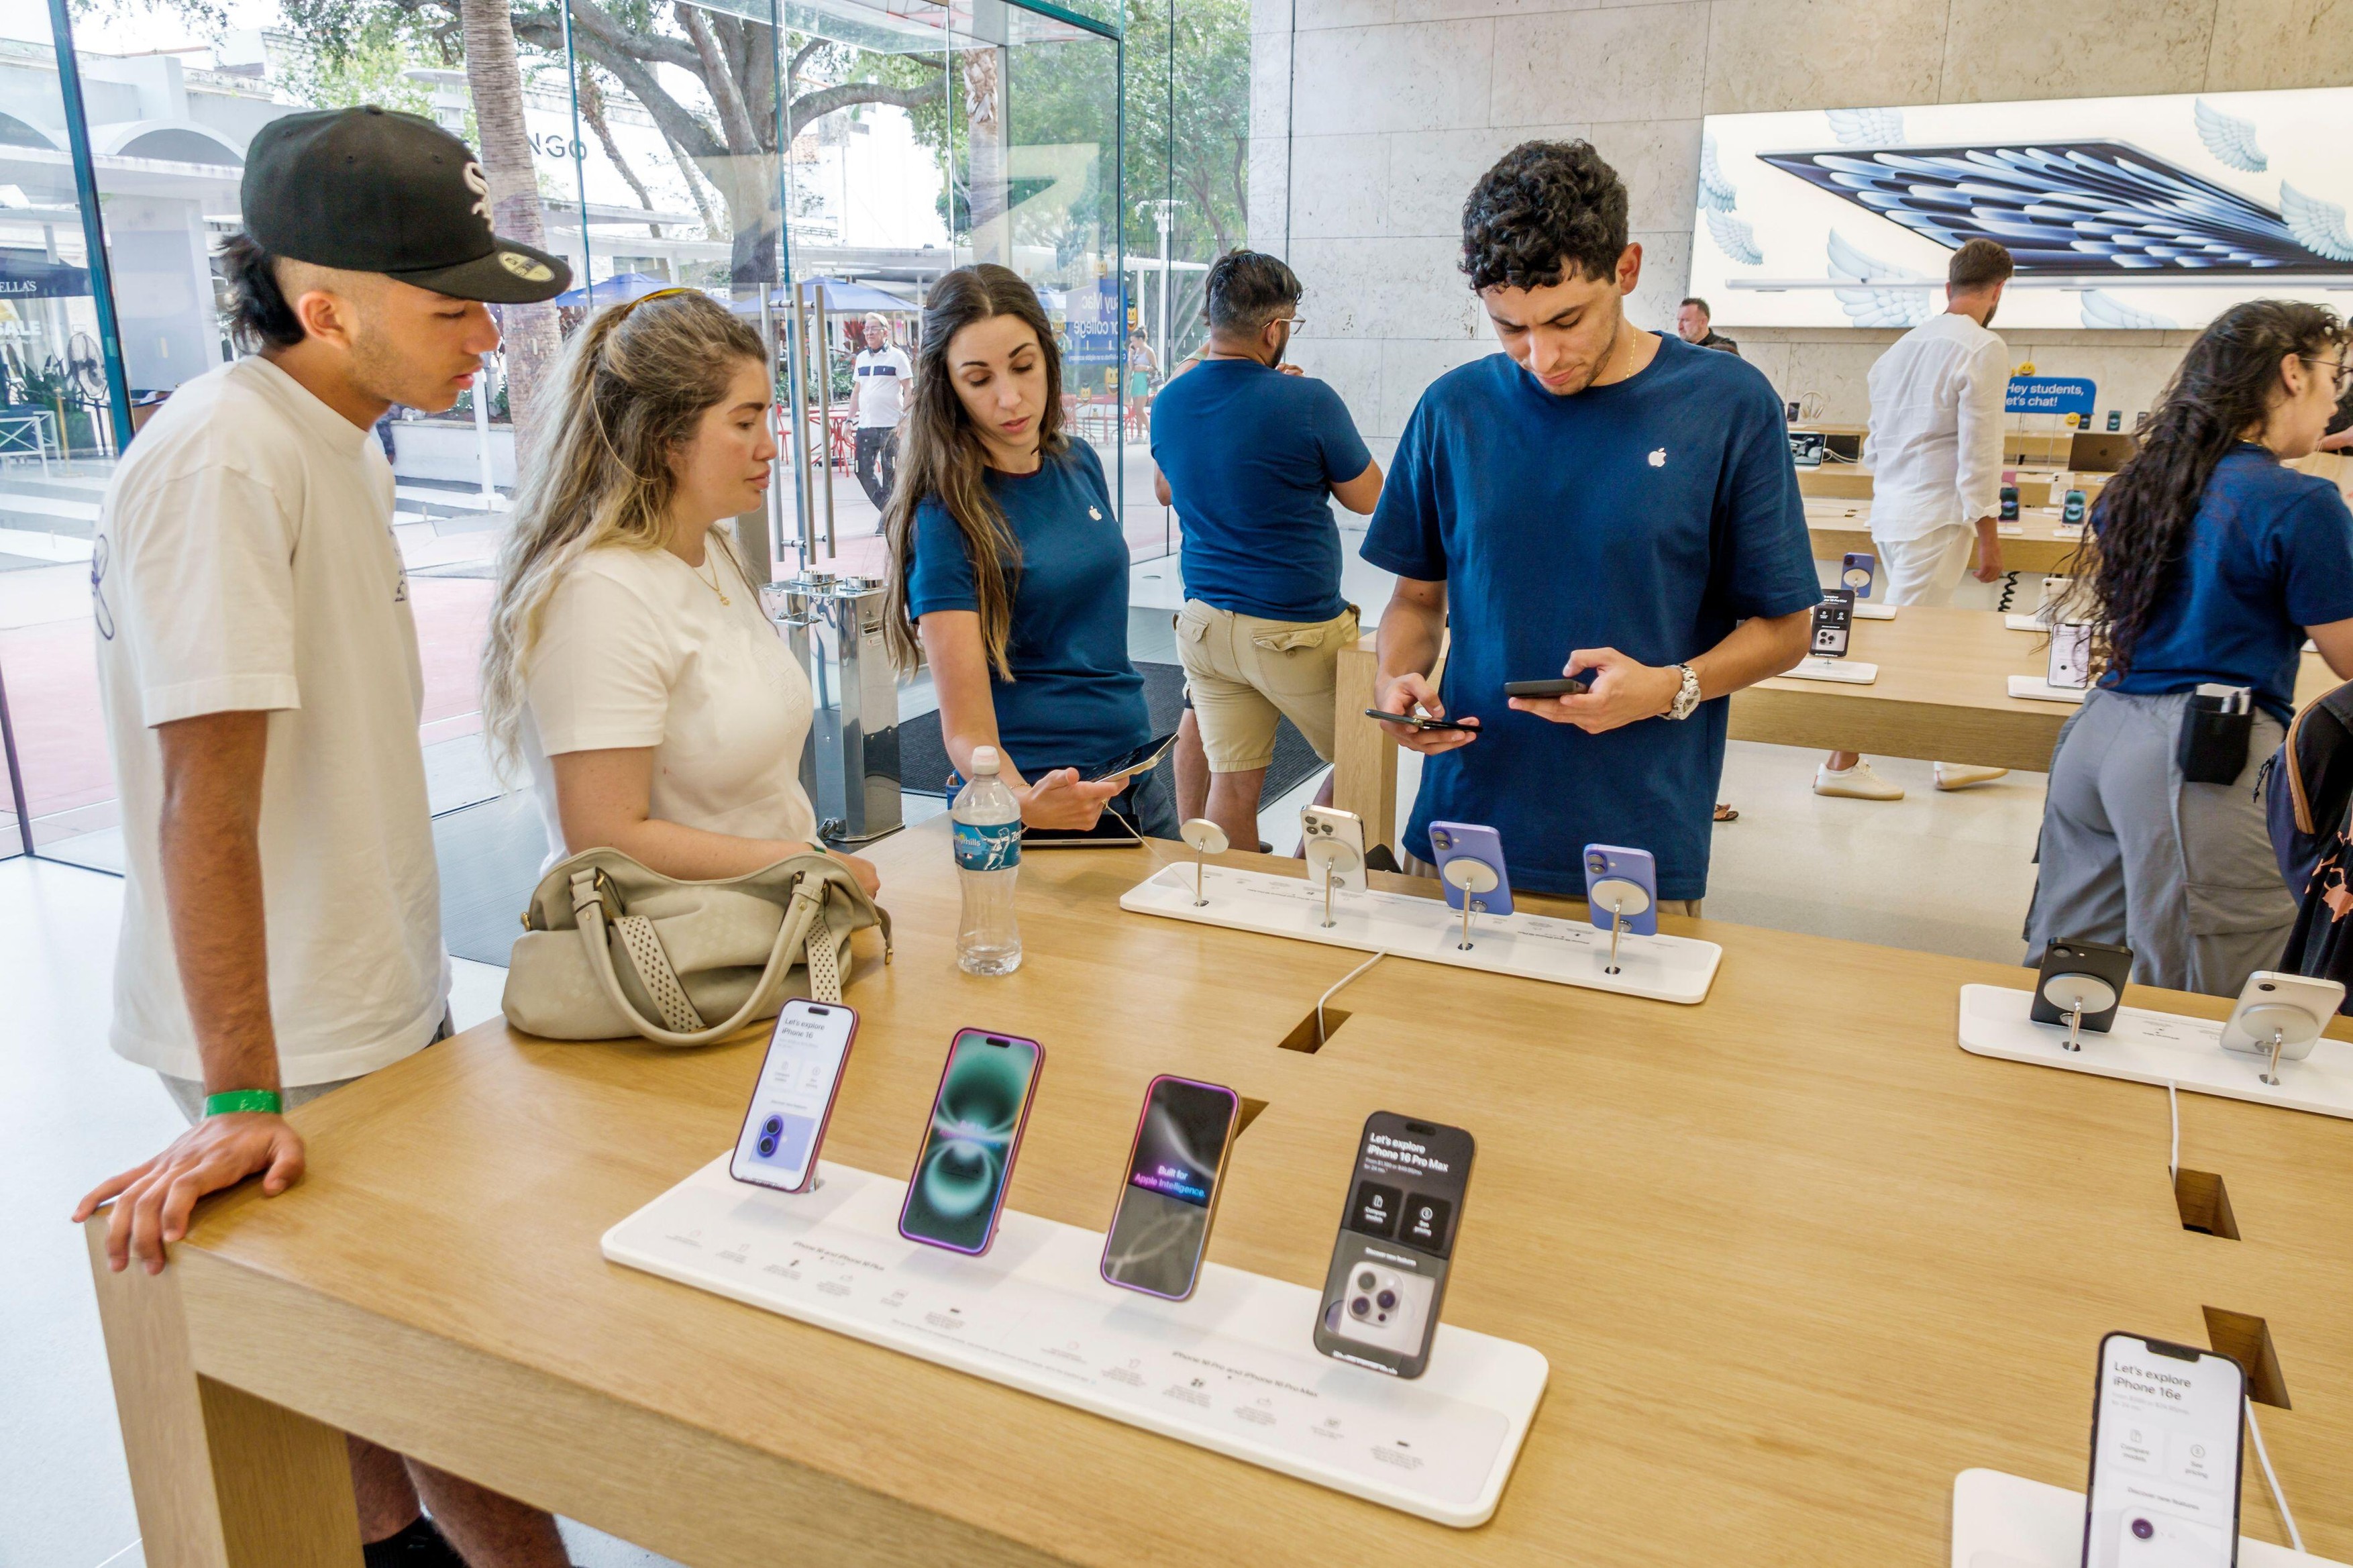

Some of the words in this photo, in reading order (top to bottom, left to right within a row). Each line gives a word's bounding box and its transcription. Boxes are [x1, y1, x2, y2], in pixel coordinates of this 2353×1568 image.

[2007, 383, 2028, 395] Hey
[2030, 384, 2084, 396] students,
[2005, 396, 2026, 406] et's
[2028, 397, 2058, 407] chat!
[784, 1017, 800, 1026] Let's
[801, 1021, 825, 1031] explore
[782, 1027, 804, 1037] iPhone
[1369, 1132, 1392, 1147] Let's
[1392, 1139, 1426, 1155] explore
[1366, 1143, 1398, 1160] iPhone
[1399, 1151, 1411, 1163] 16
[1411, 1154, 1428, 1167] Pro
[1428, 1158, 1449, 1173] Max
[1134, 1173, 1157, 1186] Apple
[1158, 1165, 1176, 1178] Built
[1177, 1170, 1188, 1180] for
[2114, 1361, 2143, 1376] Let's
[2146, 1371, 2191, 1388] explore
[2113, 1375, 2156, 1394] iPhone
[2160, 1386, 2182, 1400] 16e
